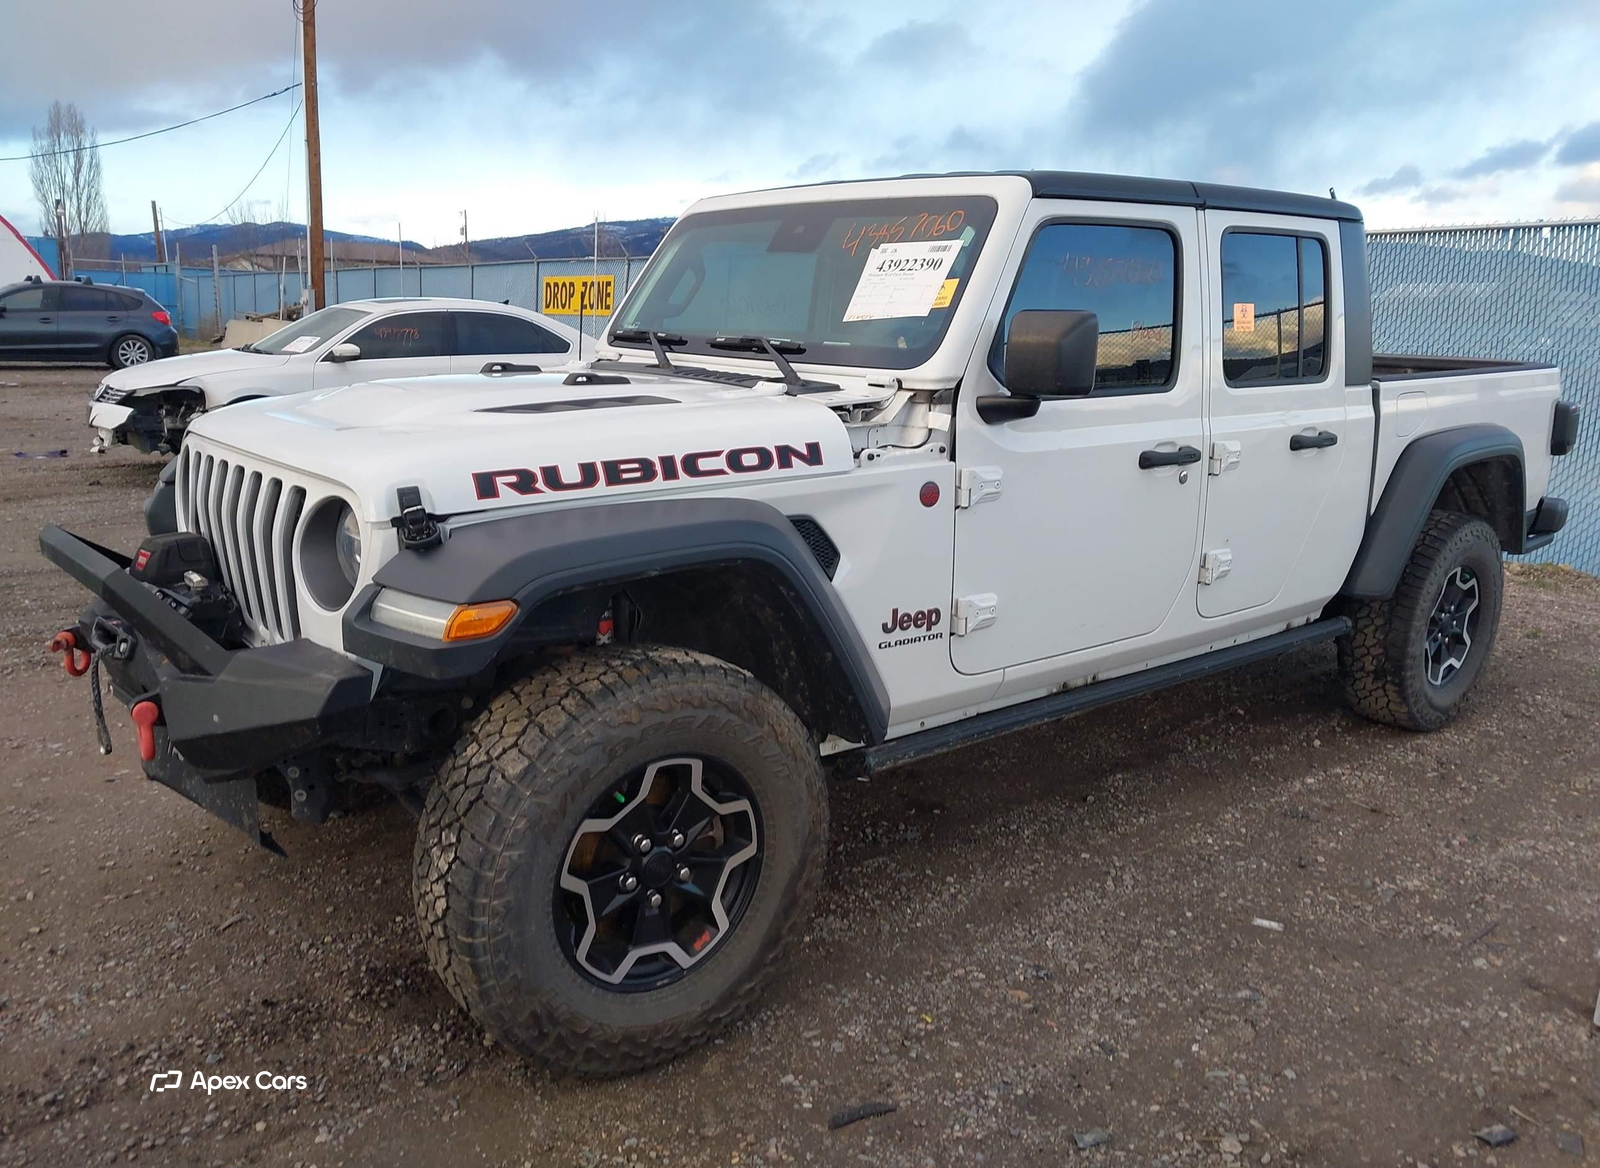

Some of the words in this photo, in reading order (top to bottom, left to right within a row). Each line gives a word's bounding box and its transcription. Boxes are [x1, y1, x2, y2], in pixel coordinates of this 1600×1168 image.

[876, 257, 944, 272] 43922390
[545, 281, 575, 310] DROP
[581, 281, 612, 311] ZONE
[471, 441, 824, 500] RUBICON
[882, 607, 941, 634] Jeep
[878, 632, 943, 650] GLADIATOR
